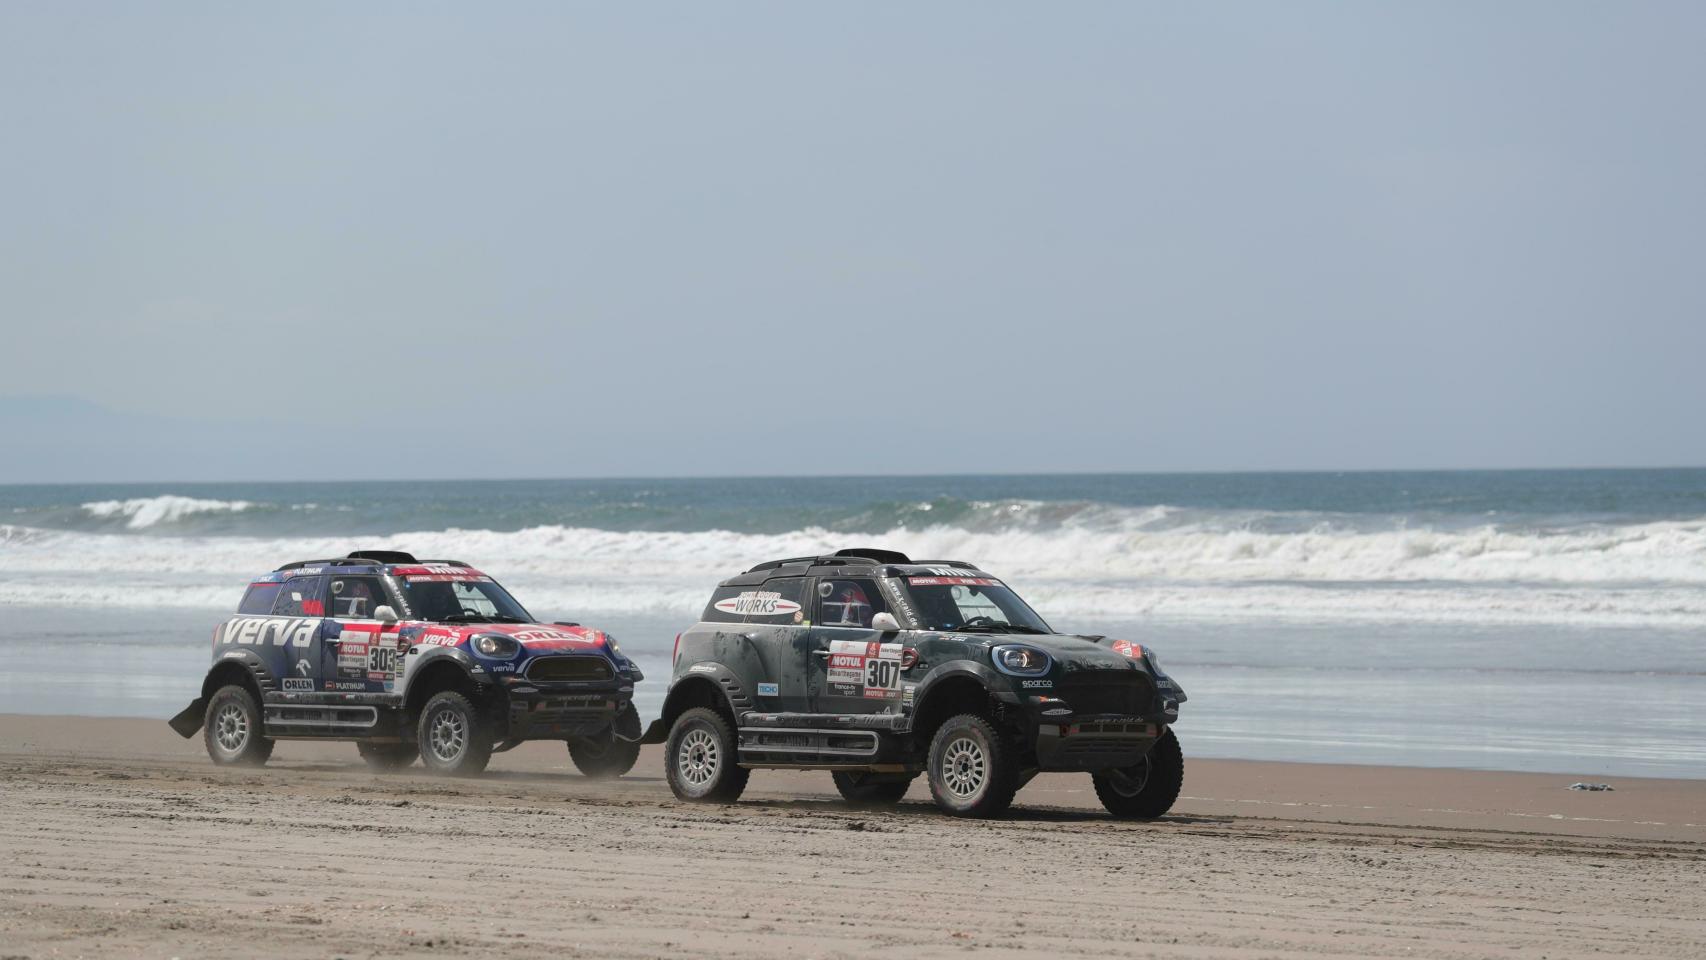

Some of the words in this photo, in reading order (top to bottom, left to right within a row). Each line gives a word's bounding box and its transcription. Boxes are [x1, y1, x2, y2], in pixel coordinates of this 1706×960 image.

[735, 599, 778, 613] WORKS
[223, 618, 321, 648] verva
[423, 635, 460, 647] verva
[341, 644, 366, 654] MOTUL
[369, 647, 397, 673] 303
[831, 655, 862, 667] MOTUL
[867, 660, 901, 689] 307
[284, 680, 313, 690] ORLEN
[1021, 680, 1053, 688] sparco
